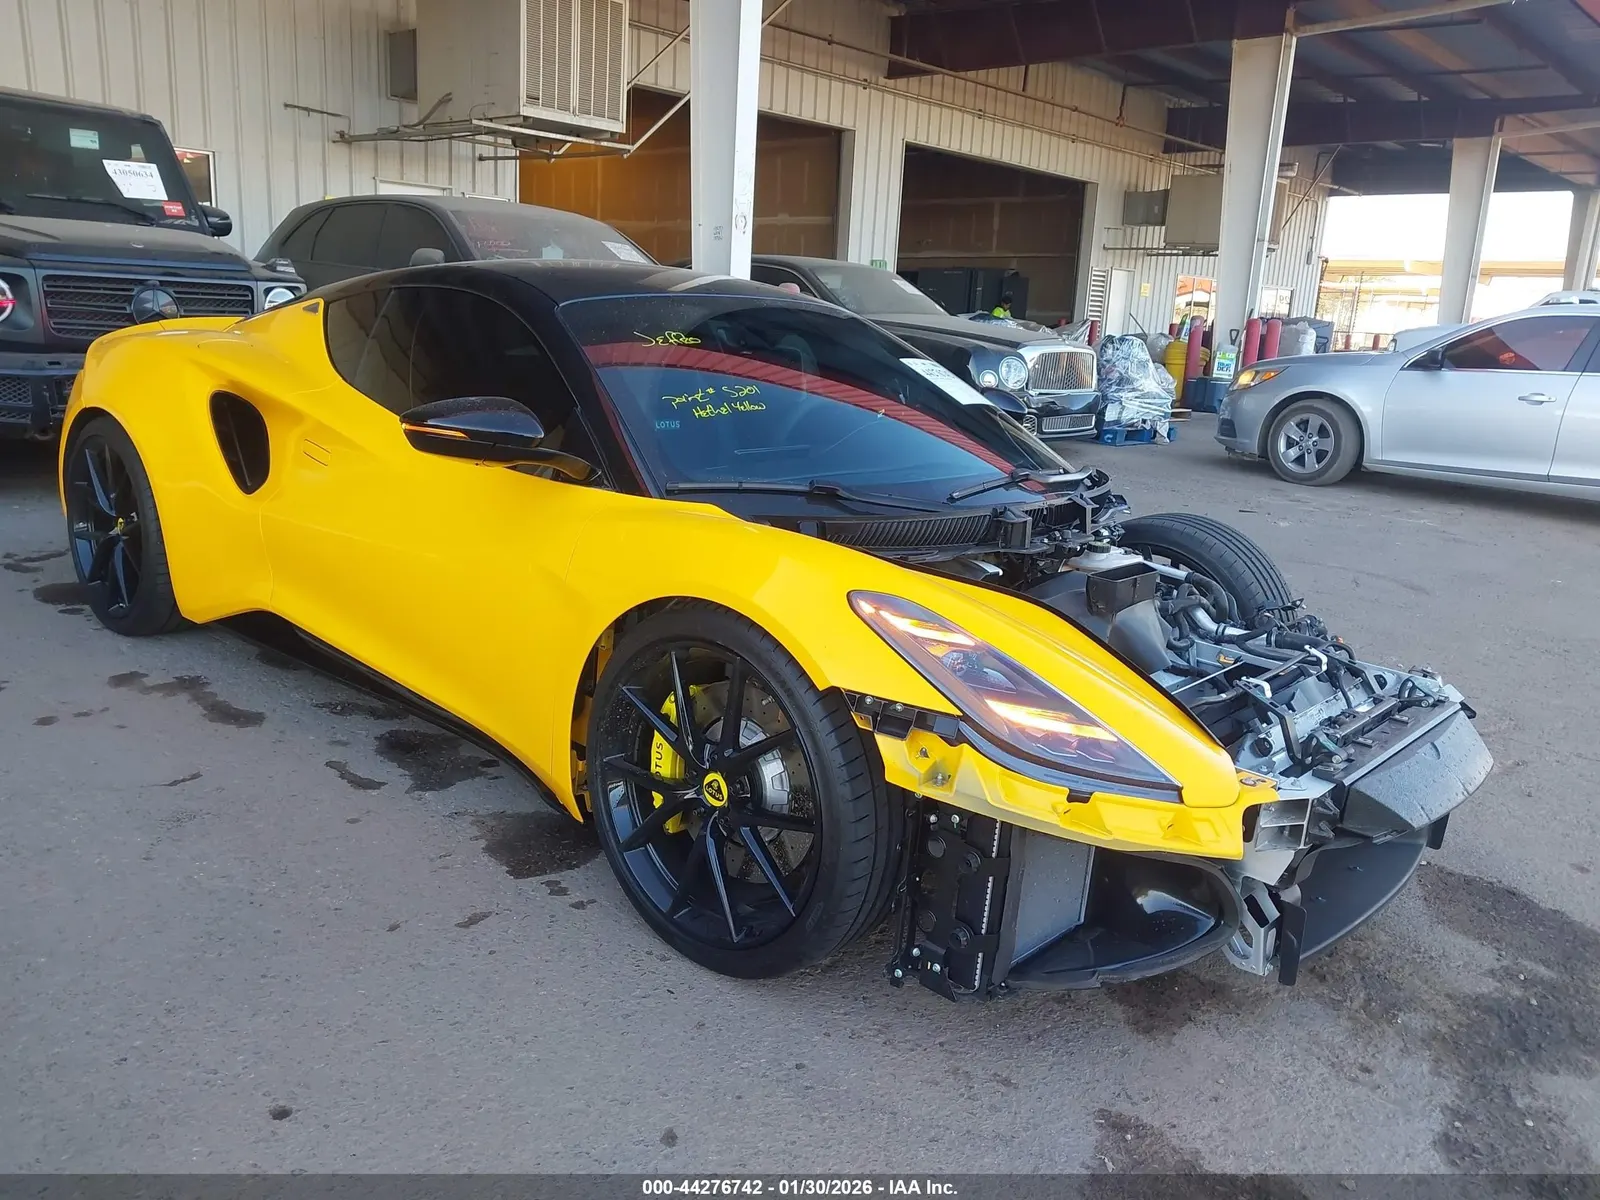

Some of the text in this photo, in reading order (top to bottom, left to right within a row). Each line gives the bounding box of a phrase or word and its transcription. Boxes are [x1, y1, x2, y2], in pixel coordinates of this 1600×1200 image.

[655, 421, 681, 430] LOTUS
[654, 742, 664, 778] OTUS
[705, 784, 723, 800] LOTUS
